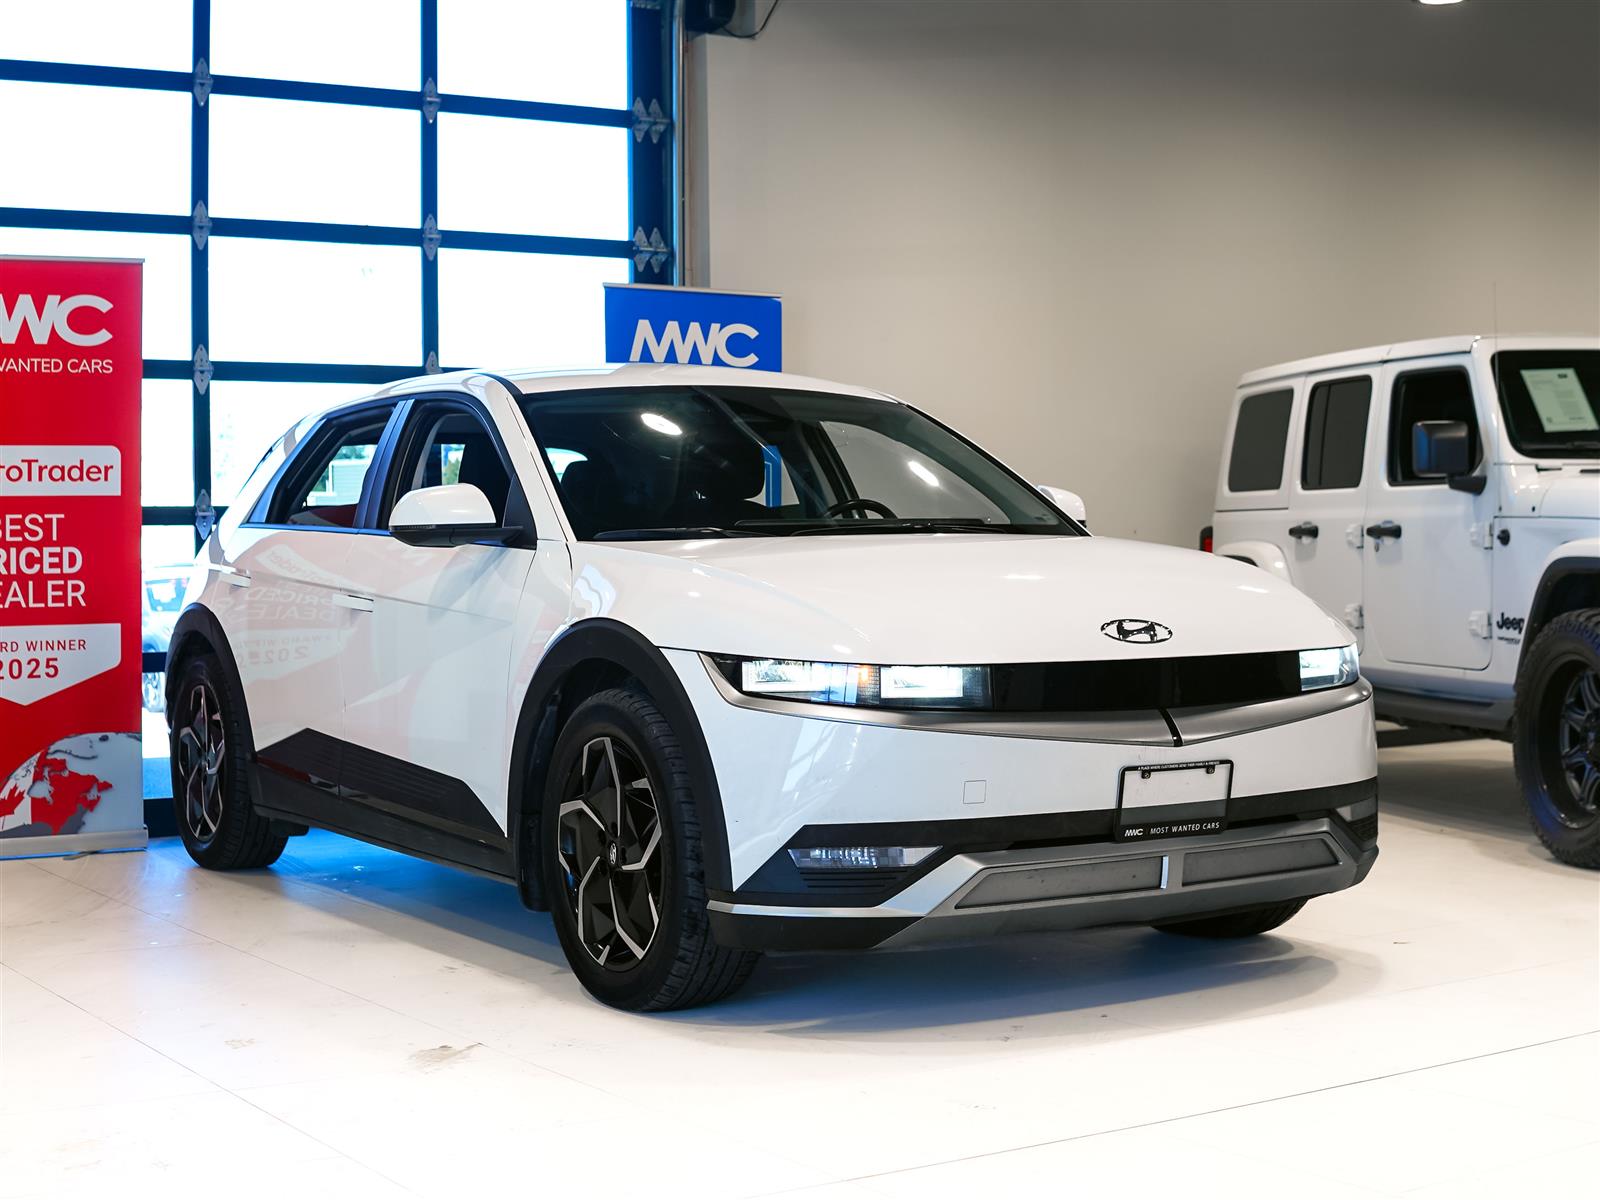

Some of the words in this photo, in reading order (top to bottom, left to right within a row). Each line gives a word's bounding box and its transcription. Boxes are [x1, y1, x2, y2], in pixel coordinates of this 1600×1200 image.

[0, 293, 113, 347] WC
[628, 319, 759, 367] MWC
[67, 359, 113, 374] CARS
[0, 459, 113, 482] oTrader
[0, 513, 65, 542] EST
[0, 579, 86, 608] ALER
[1496, 612, 1525, 634] Jeep
[25, 639, 87, 652] WINNER
[1124, 828, 1144, 837] MWC
[1150, 826, 1169, 835] MOST
[1171, 823, 1200, 833] WANTED
[1202, 821, 1220, 830] CARS
